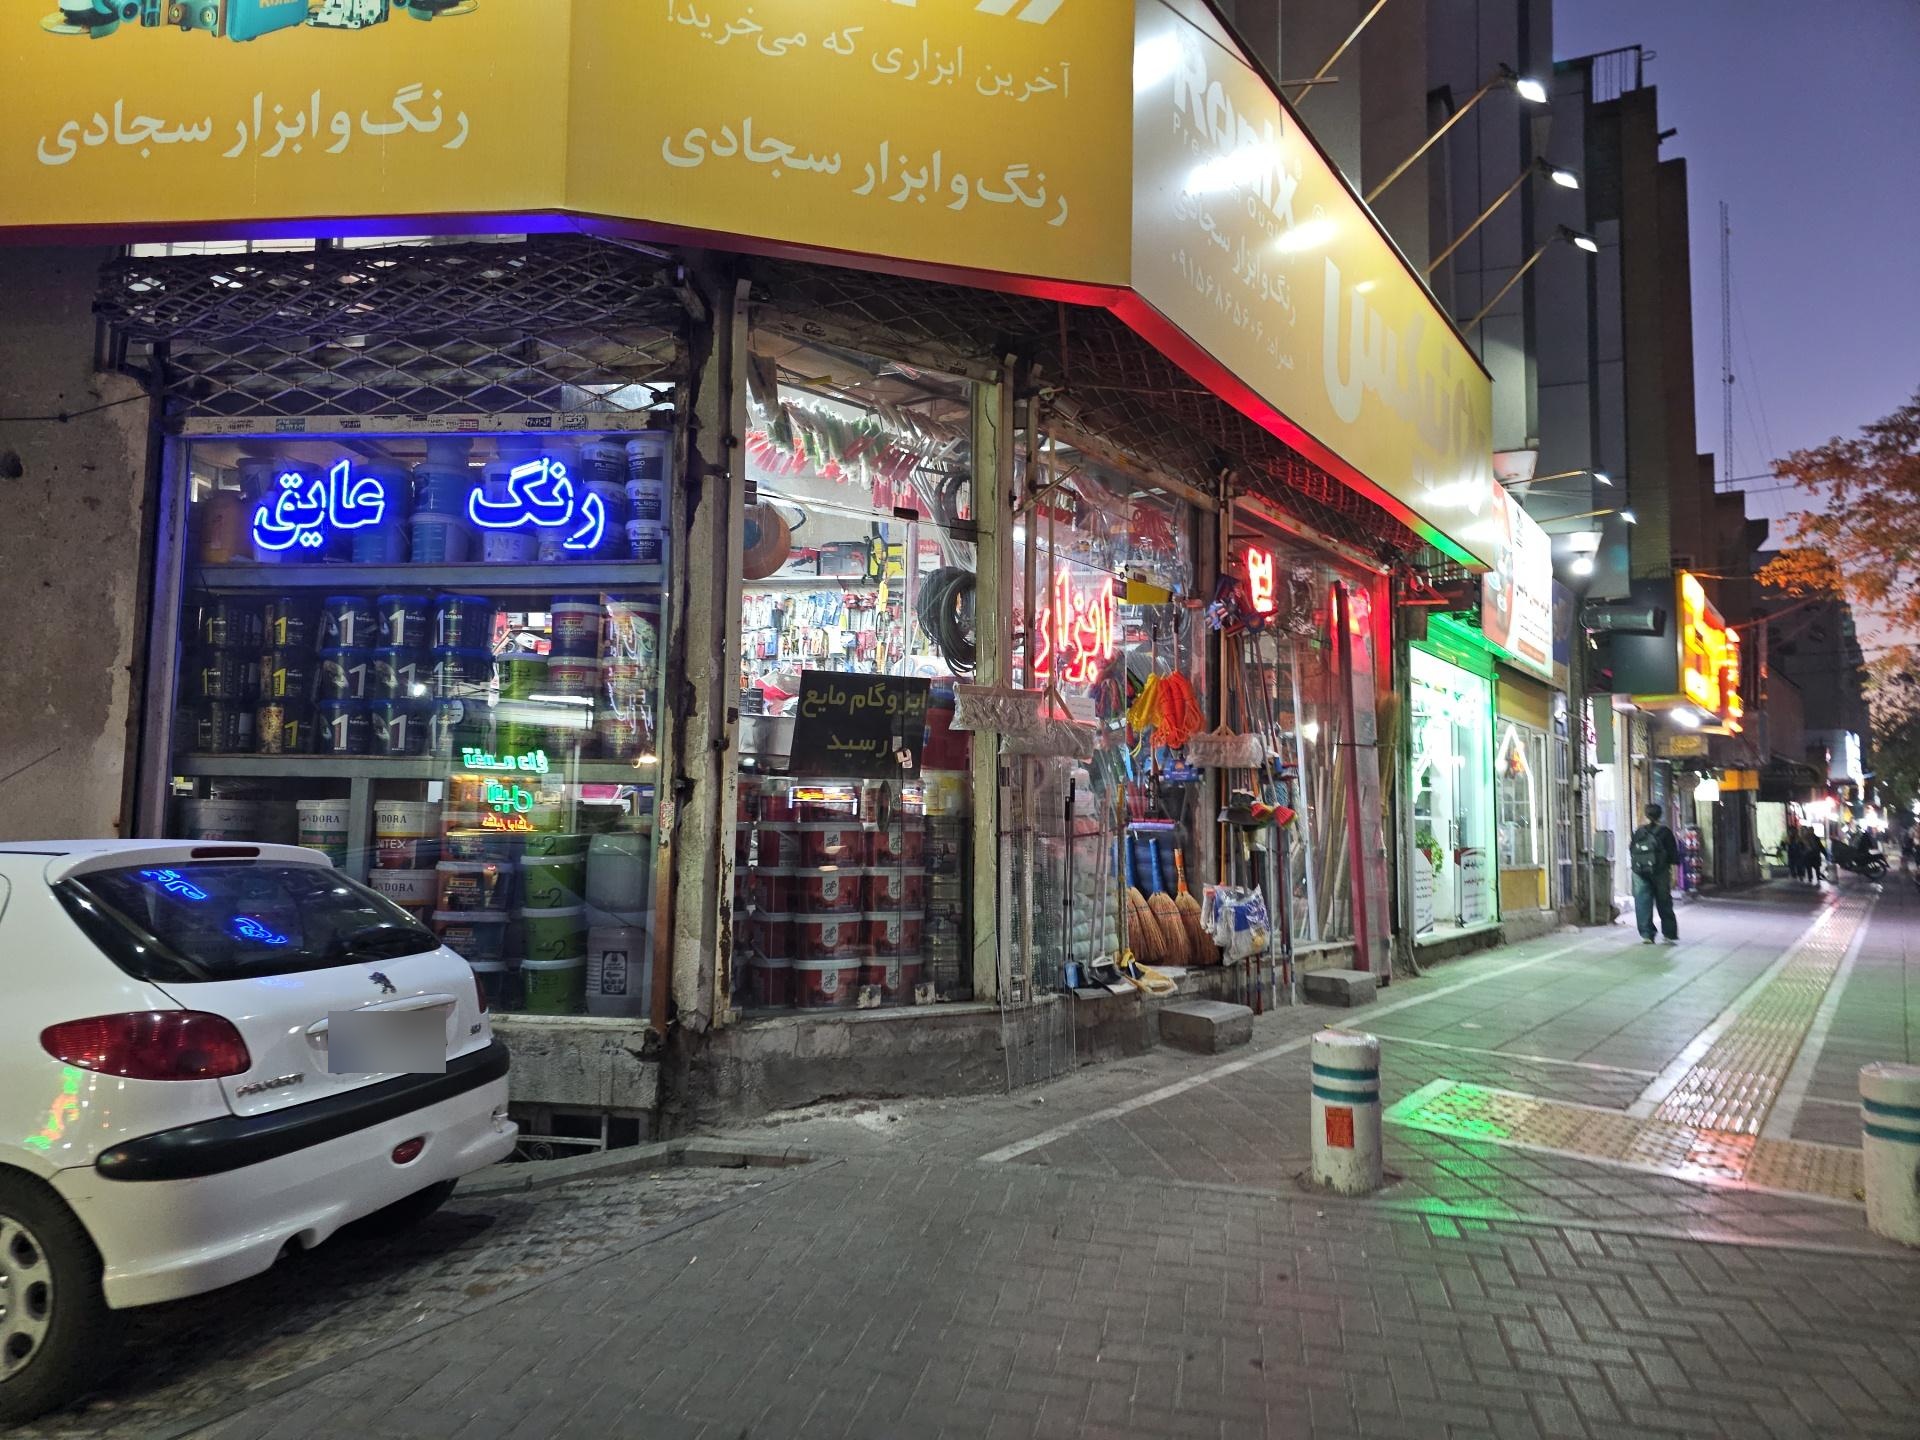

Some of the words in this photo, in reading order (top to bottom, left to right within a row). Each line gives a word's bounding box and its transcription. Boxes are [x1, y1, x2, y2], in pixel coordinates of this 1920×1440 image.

[822, 27, 864, 56] که
[872, 40, 963, 87] ابزاری
[976, 62, 1071, 102] آخرین
[37, 98, 212, 165] سجادی
[223, 89, 320, 157] ابزار
[326, 115, 351, 153] و
[360, 83, 469, 149] رنگ
[662, 117, 841, 178] سجادی
[853, 141, 941, 203] ابزار
[947, 174, 970, 210] و
[976, 164, 1069, 227] رنگ
[1232, 235, 1261, 288] ابزار
[1270, 276, 1297, 327] رنگ
[253, 459, 384, 550] عایق
[469, 458, 605, 549] رنگ
[338, 611, 354, 646] 1
[389, 610, 404, 645] 1
[1035, 567, 1113, 682] ابزار
[349, 664, 366, 698] 1
[802, 684, 844, 717] مایع
[850, 683, 926, 716] ایزوگام
[332, 715, 348, 750] 1
[389, 715, 407, 750] 1
[827, 733, 888, 757] رسید
[548, 887, 562, 908] 2
[552, 940, 566, 960] 2
